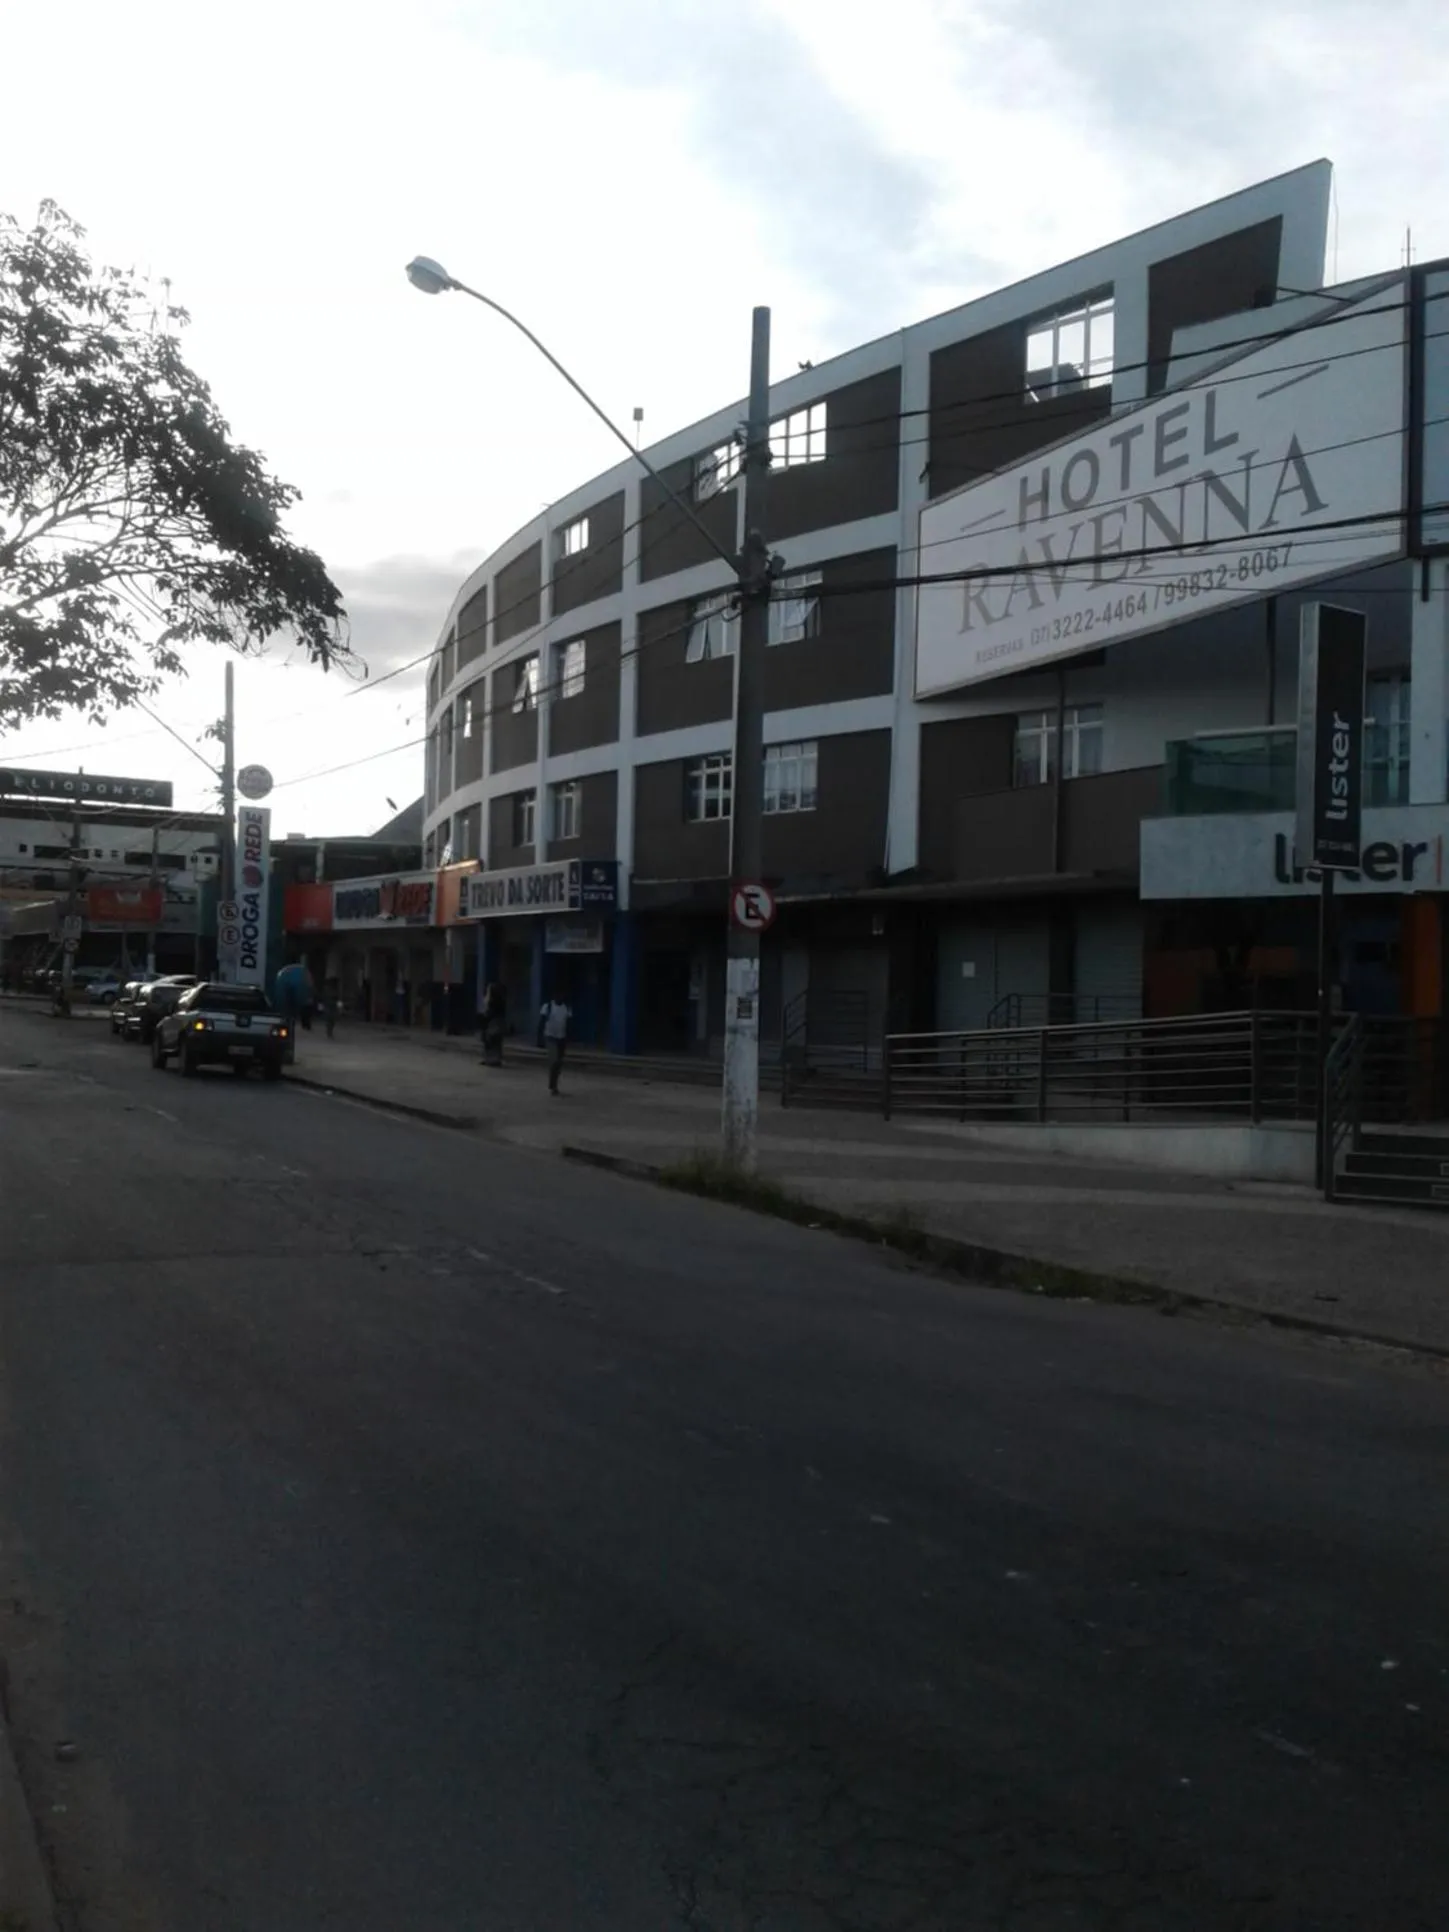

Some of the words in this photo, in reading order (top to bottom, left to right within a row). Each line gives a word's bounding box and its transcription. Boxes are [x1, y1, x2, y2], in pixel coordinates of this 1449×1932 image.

[1018, 390, 1239, 532] HOTEL
[957, 432, 1329, 635] RAVENNA
[243, 811, 264, 862] REDE
[240, 893, 260, 969] DROGA
[745, 893, 761, 919] E
